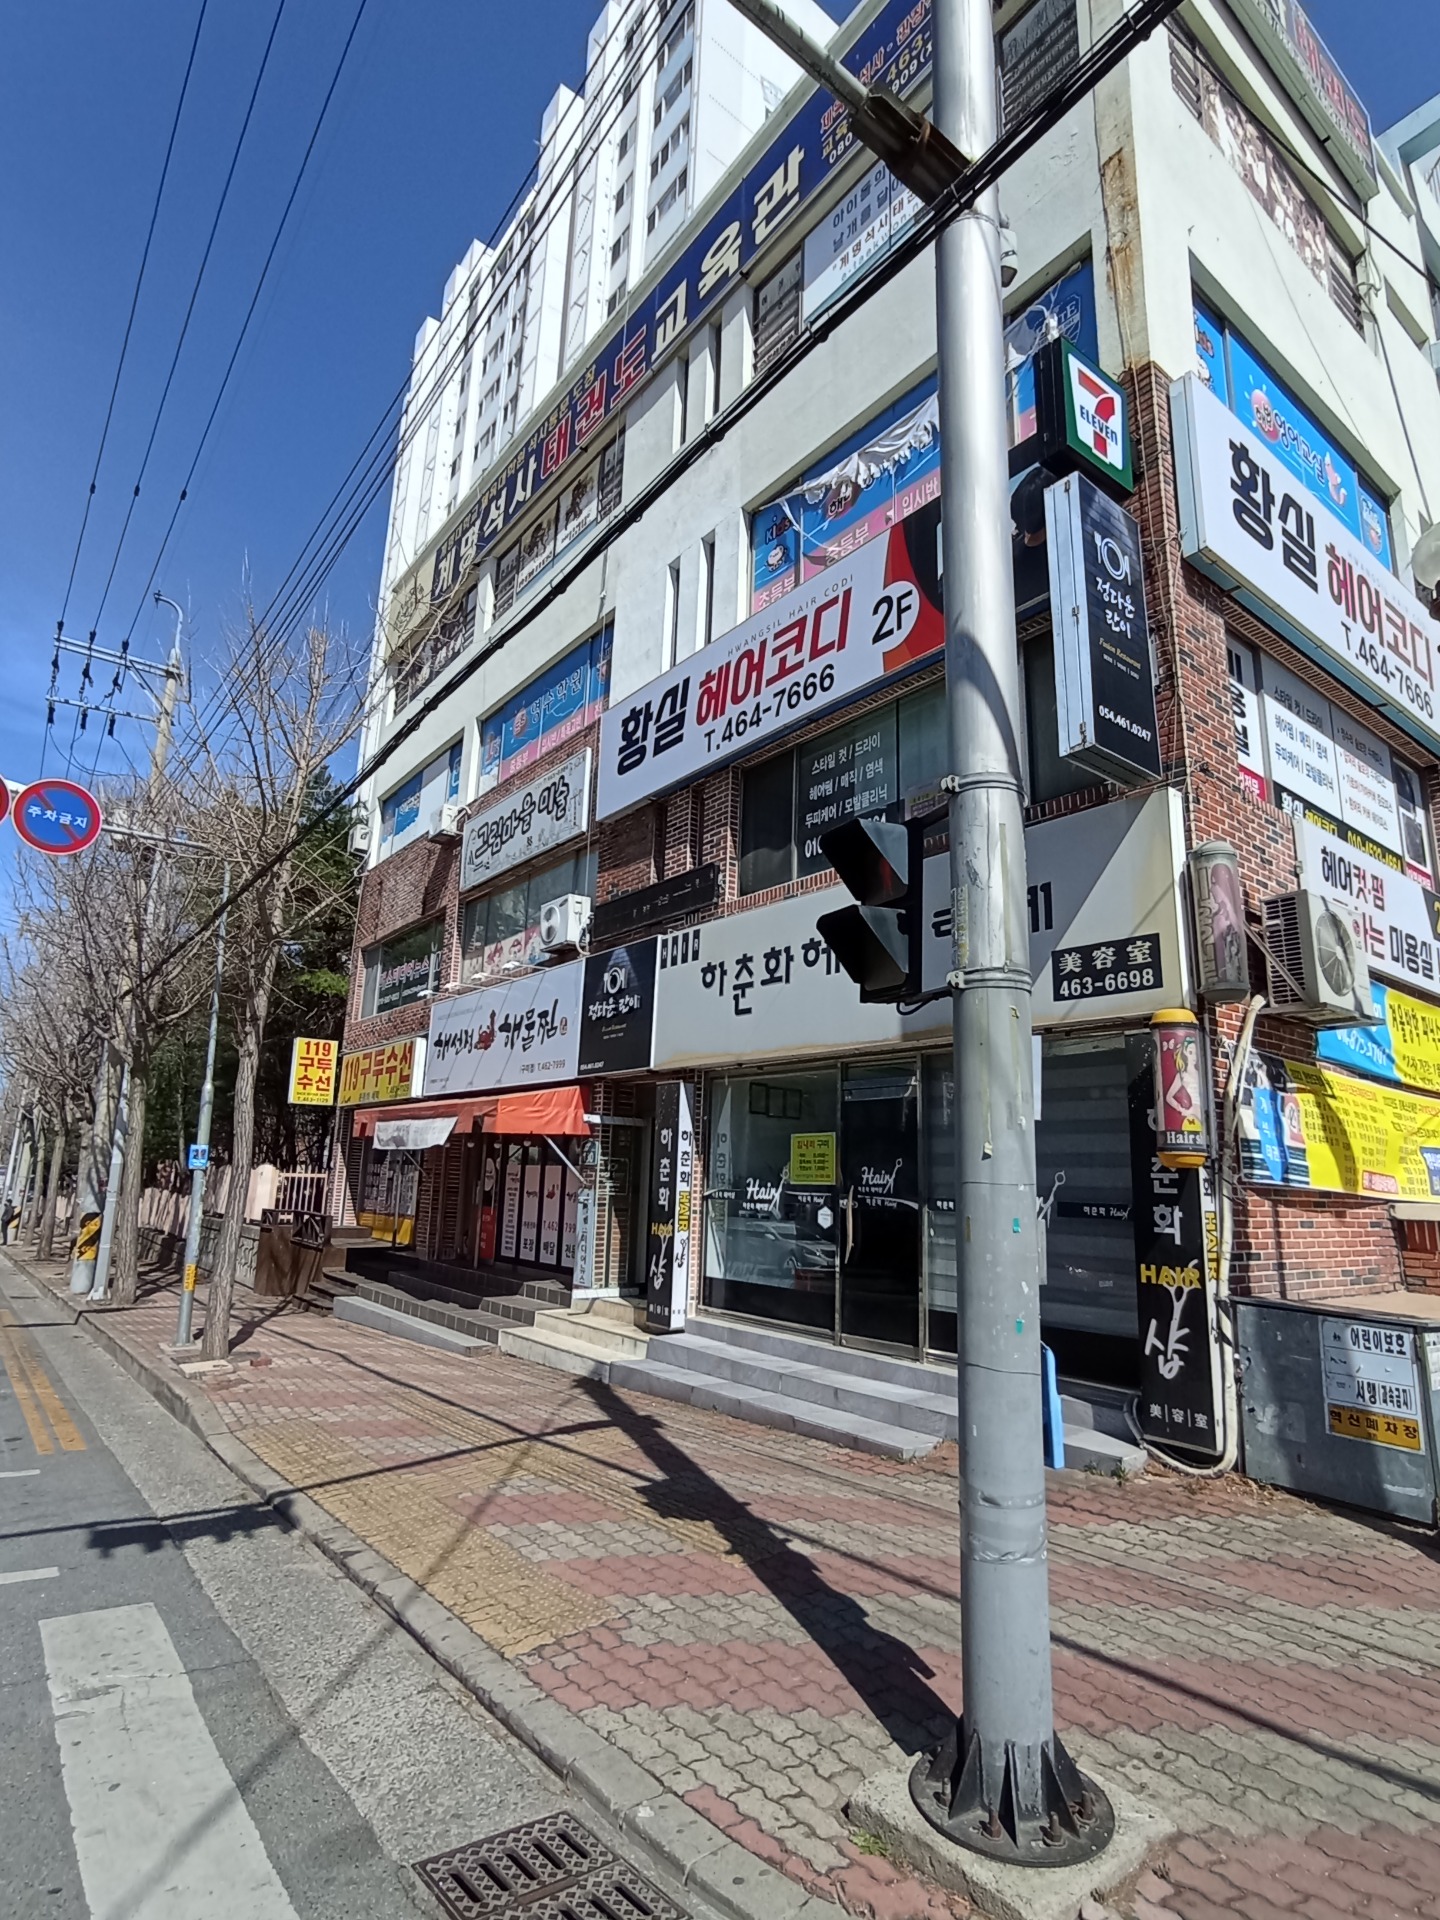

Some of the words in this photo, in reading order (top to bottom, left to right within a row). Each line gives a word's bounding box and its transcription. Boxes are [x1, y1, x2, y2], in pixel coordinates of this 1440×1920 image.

[1080, 405, 1118, 446] ELEVEN
[1229, 438, 1318, 594] 황실
[1325, 542, 1434, 692] 헤어코디
[789, 597, 817, 619] HAIR
[824, 574, 853, 597] CODI
[872, 589, 913, 645] 2F
[617, 676, 690, 776] 황실
[696, 587, 852, 726] 헤어코디
[703, 663, 835, 754] T.464-7666
[812, 752, 835, 775] 스타일
[838, 746, 847, 764] 컷
[855, 732, 880, 756] 드라이
[840, 768, 857, 788] 매직
[866, 758, 883, 779] 염색
[27, 805, 88, 828] 주차금지
[805, 803, 837, 828] 두피케어
[1061, 941, 1157, 977] 美容室
[1389, 925, 1434, 980] 미용실
[701, 945, 794, 1016] 하춘화
[1061, 968, 1157, 999] 463-6698
[299, 1057, 332, 1074] 구두
[305, 1040, 332, 1056] 119
[297, 1074, 330, 1092] 수선
[657, 1128, 672, 1212] 하춘화
[681, 1130, 692, 1188] 하춘화
[677, 1190, 690, 1232] HAIR
[1141, 1263, 1201, 1288] HAIR
[1350, 1326, 1407, 1355] 어린이보호
[1356, 1380, 1377, 1405] 서행
[1330, 1410, 1418, 1440] 혁신폐차장
